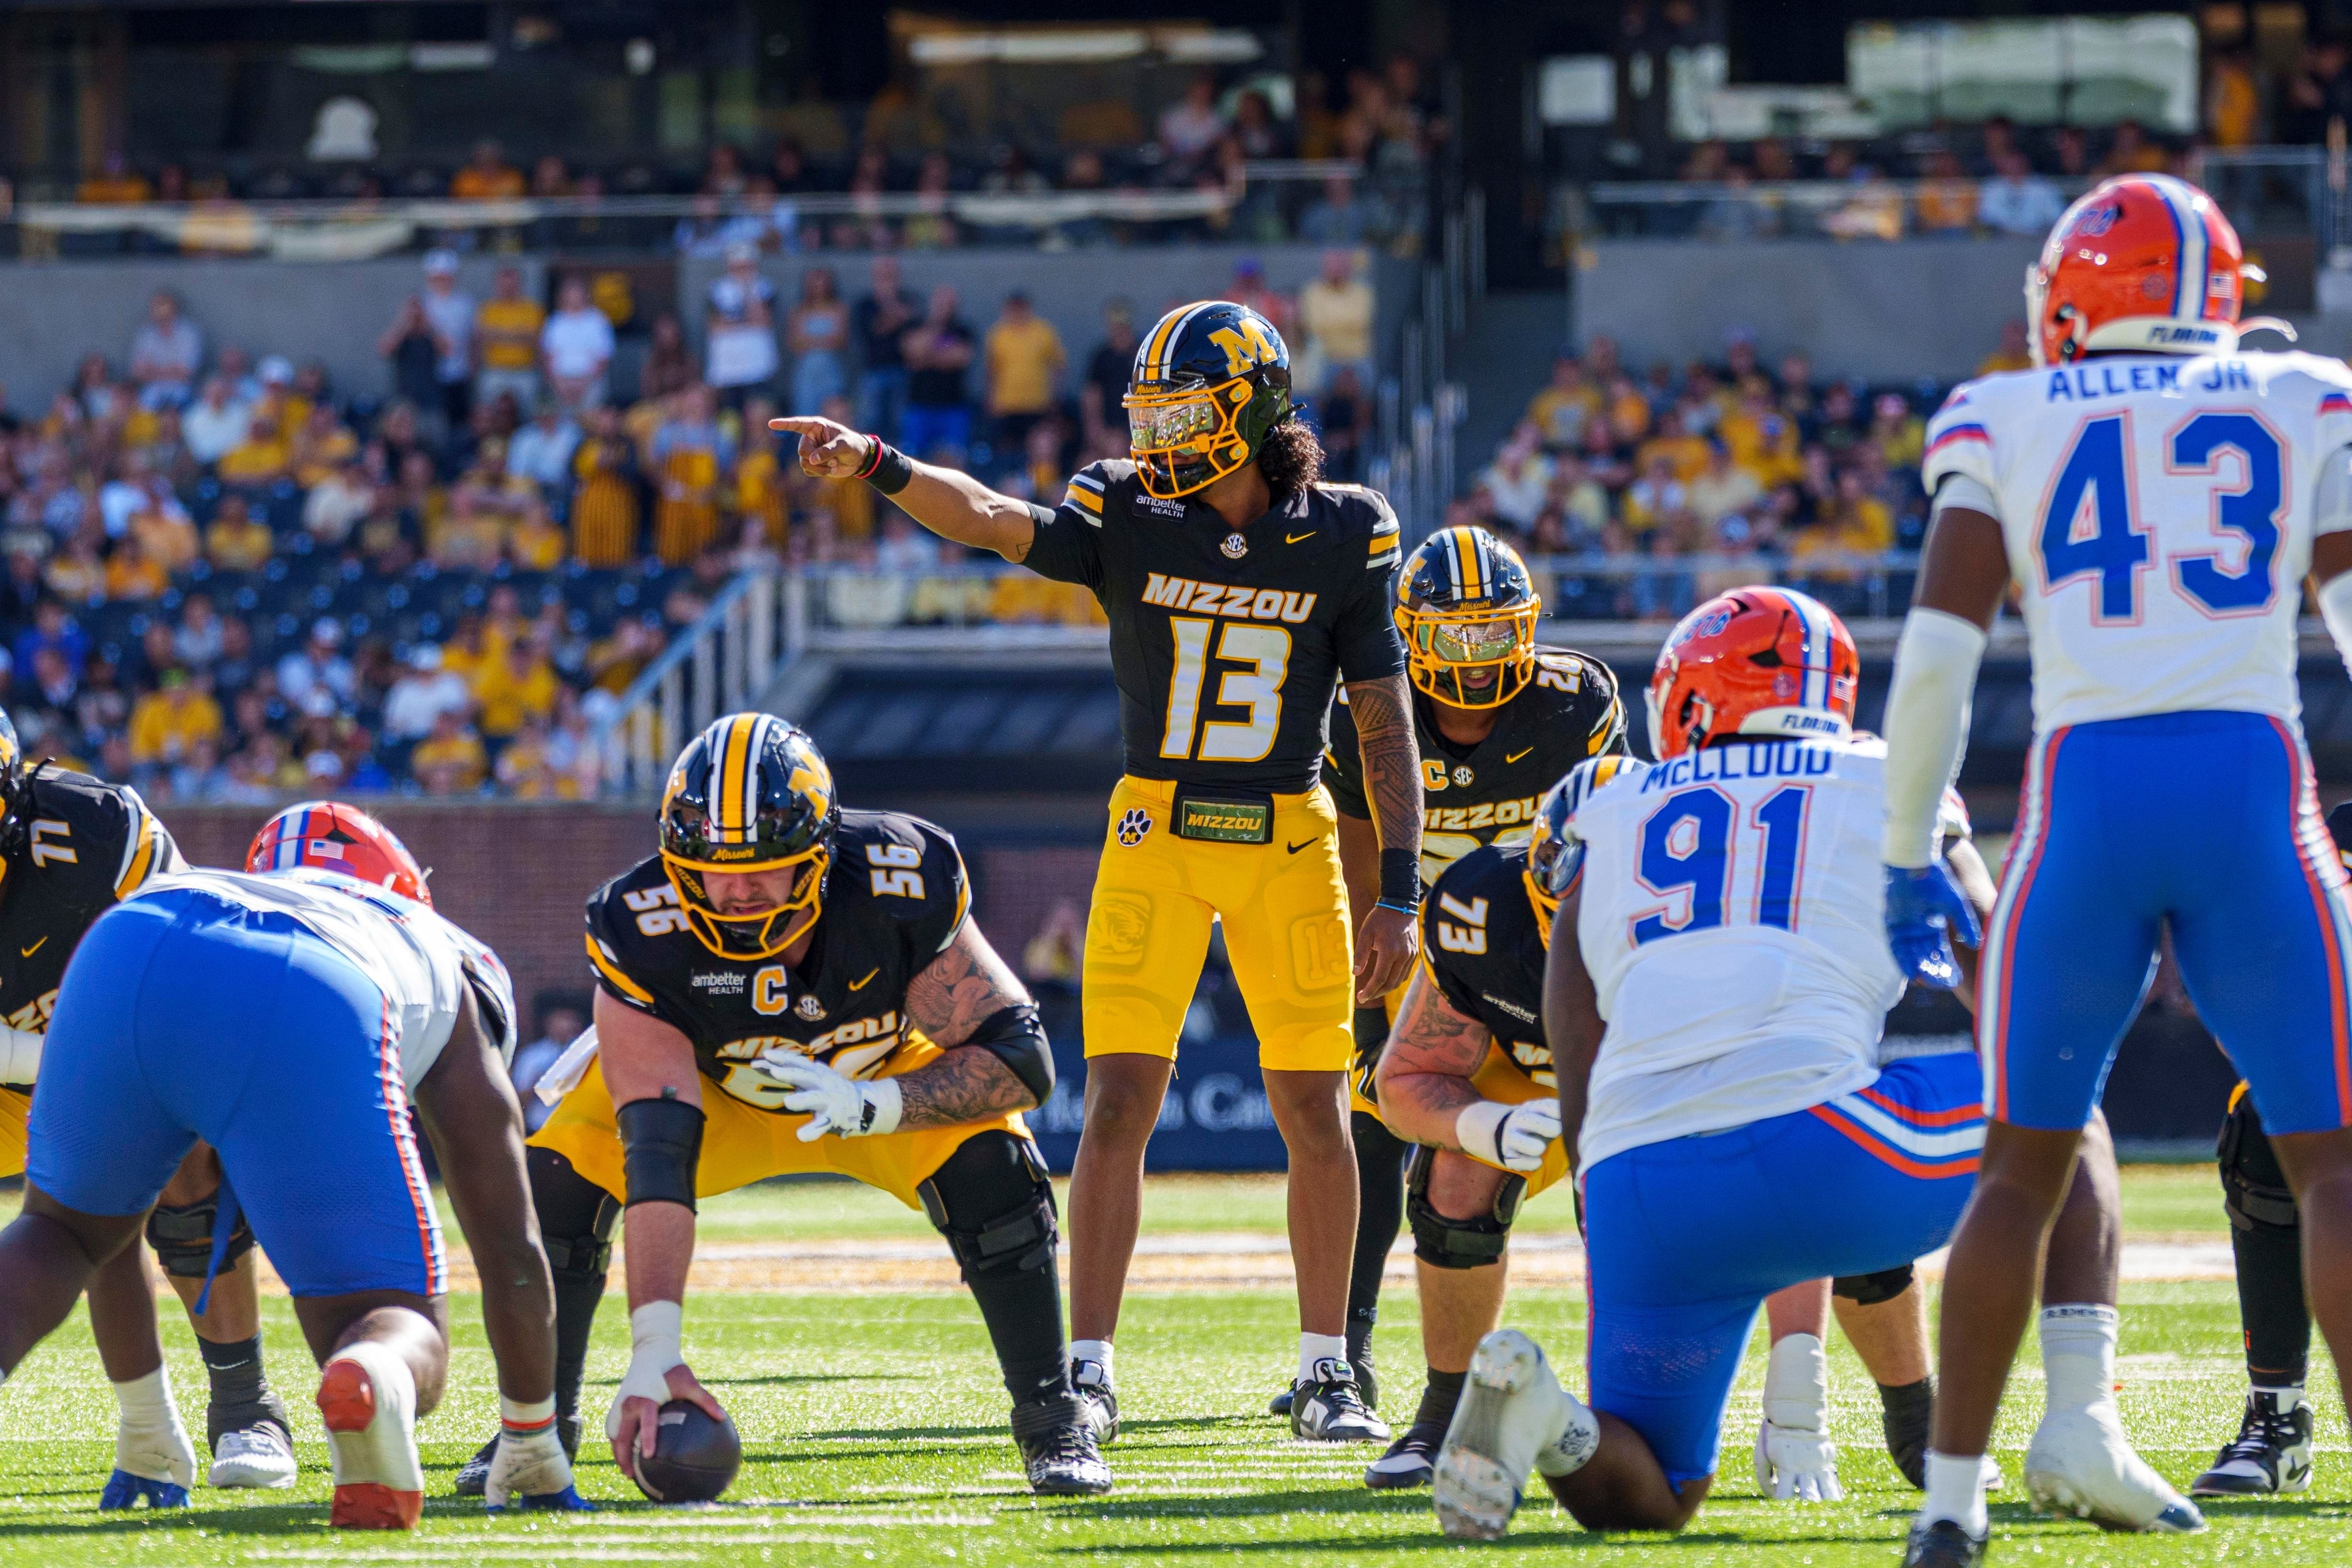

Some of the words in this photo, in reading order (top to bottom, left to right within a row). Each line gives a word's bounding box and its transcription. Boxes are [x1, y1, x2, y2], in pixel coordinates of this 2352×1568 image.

[1207, 318, 1278, 378] M
[1135, 384, 1162, 395] Missouri
[2048, 365, 2179, 401] ALLEN
[2203, 360, 2251, 391] JR
[1136, 495, 1186, 513] ambetter
[1151, 506, 1184, 519] HEALTH
[2030, 407, 2291, 627] 43
[1226, 533, 1245, 552] SEC
[1142, 573, 1317, 624] MIZZOU
[1460, 600, 1491, 612] Missouri
[1159, 616, 1292, 763] 13
[1537, 654, 1583, 695] 20
[1420, 760, 1450, 792] C
[1454, 767, 1472, 786] SEC
[1123, 831, 1137, 843] M
[1187, 813, 1262, 831] MIZZOU
[31, 819, 78, 868] 77
[712, 846, 755, 861] Missouri
[865, 843, 925, 900] 56
[1627, 782, 1814, 950] 91
[622, 883, 691, 937] 56
[1437, 891, 1490, 955] 73
[692, 971, 747, 987] ambetter
[708, 986, 744, 995] HEALTH
[752, 964, 789, 1016] C
